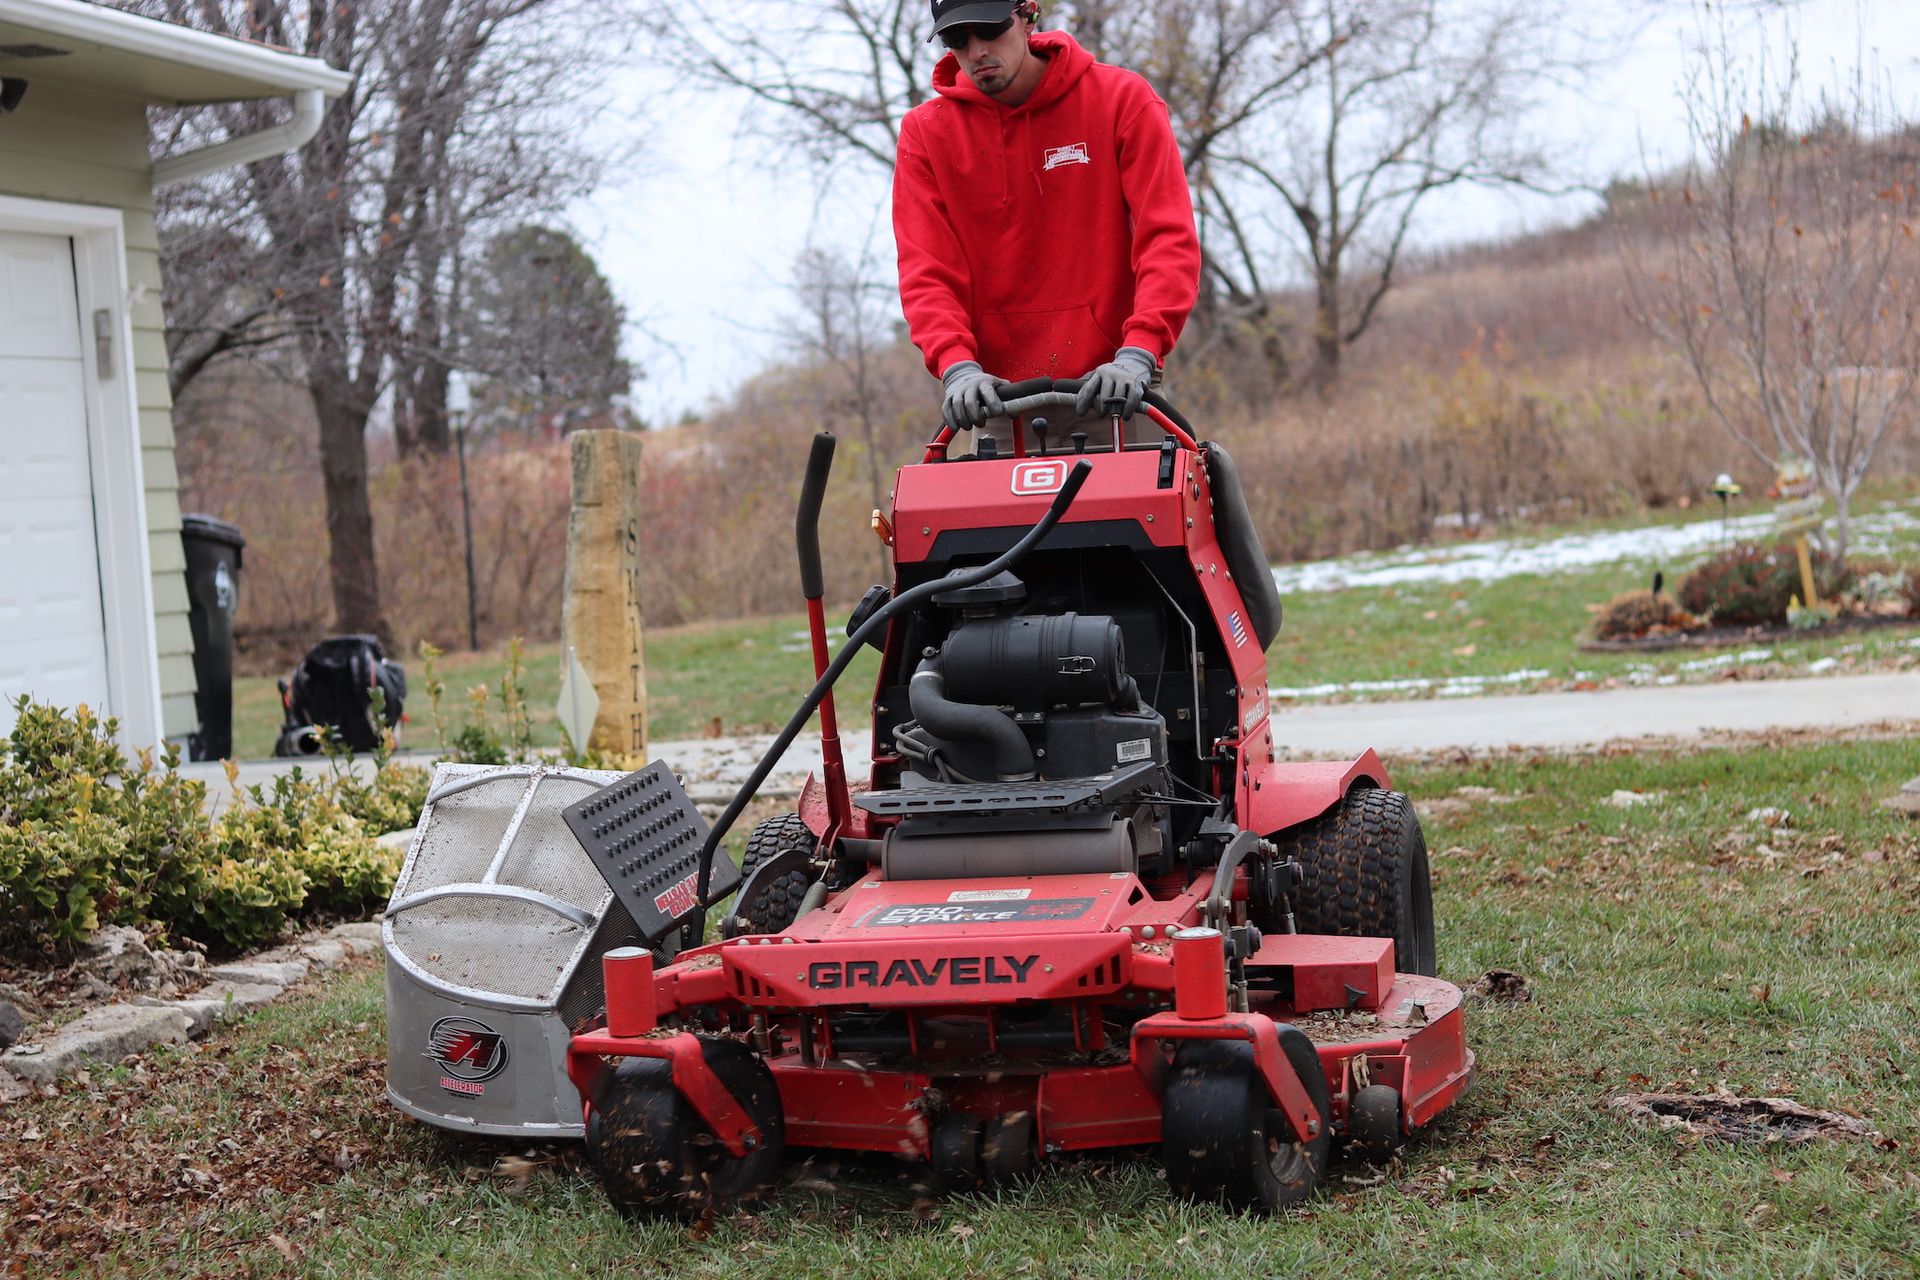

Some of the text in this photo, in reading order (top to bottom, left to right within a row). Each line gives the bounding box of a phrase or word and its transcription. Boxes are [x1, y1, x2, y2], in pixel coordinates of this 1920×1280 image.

[1023, 467, 1055, 488] G
[876, 911, 1018, 924] STANCE
[888, 906, 973, 916] PRO-
[809, 955, 1040, 989] GRAVELY
[440, 1076, 485, 1095] ACCELERATOR
